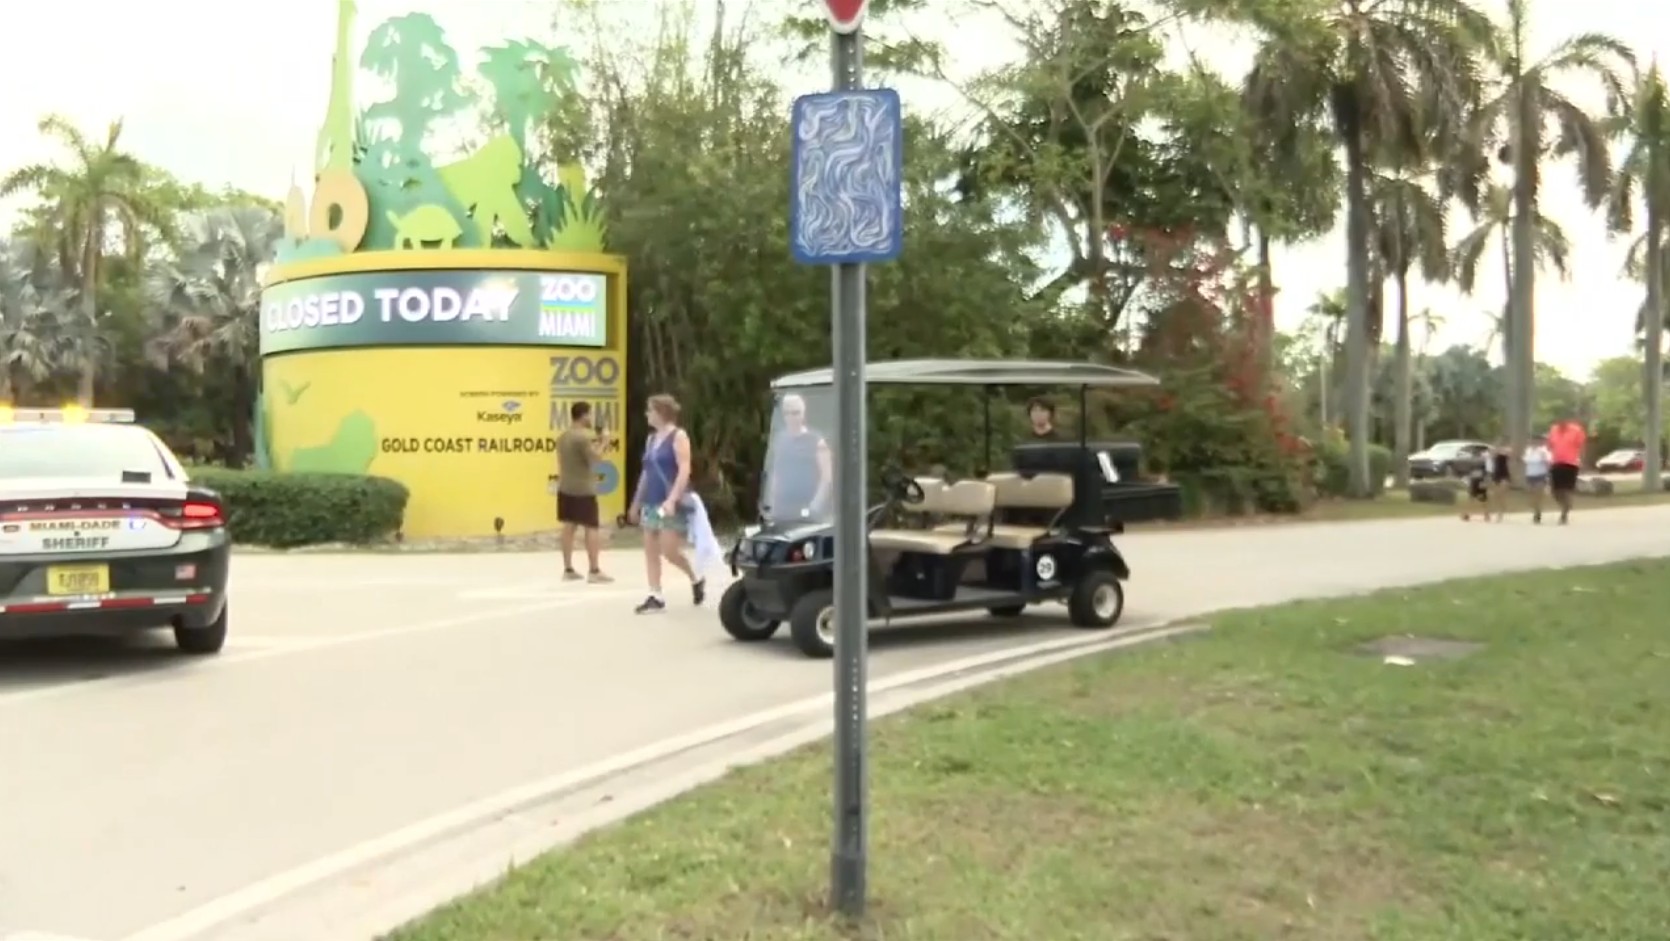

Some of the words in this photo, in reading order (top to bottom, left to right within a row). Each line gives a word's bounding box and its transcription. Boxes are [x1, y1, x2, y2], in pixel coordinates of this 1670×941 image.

[539, 276, 596, 301] ZOO
[267, 290, 364, 332] CLOSED
[374, 286, 520, 322] TODAY
[538, 313, 596, 337] MIAMI
[549, 356, 619, 385] ZOO
[477, 411, 522, 425] Kaseya
[549, 401, 619, 430] MMI
[381, 438, 419, 453] GOLD
[424, 438, 473, 453] COAST
[478, 438, 557, 453] RAILROAD
[29, 520, 121, 531] MIAMI-DADE
[42, 537, 109, 549] SHERIFF
